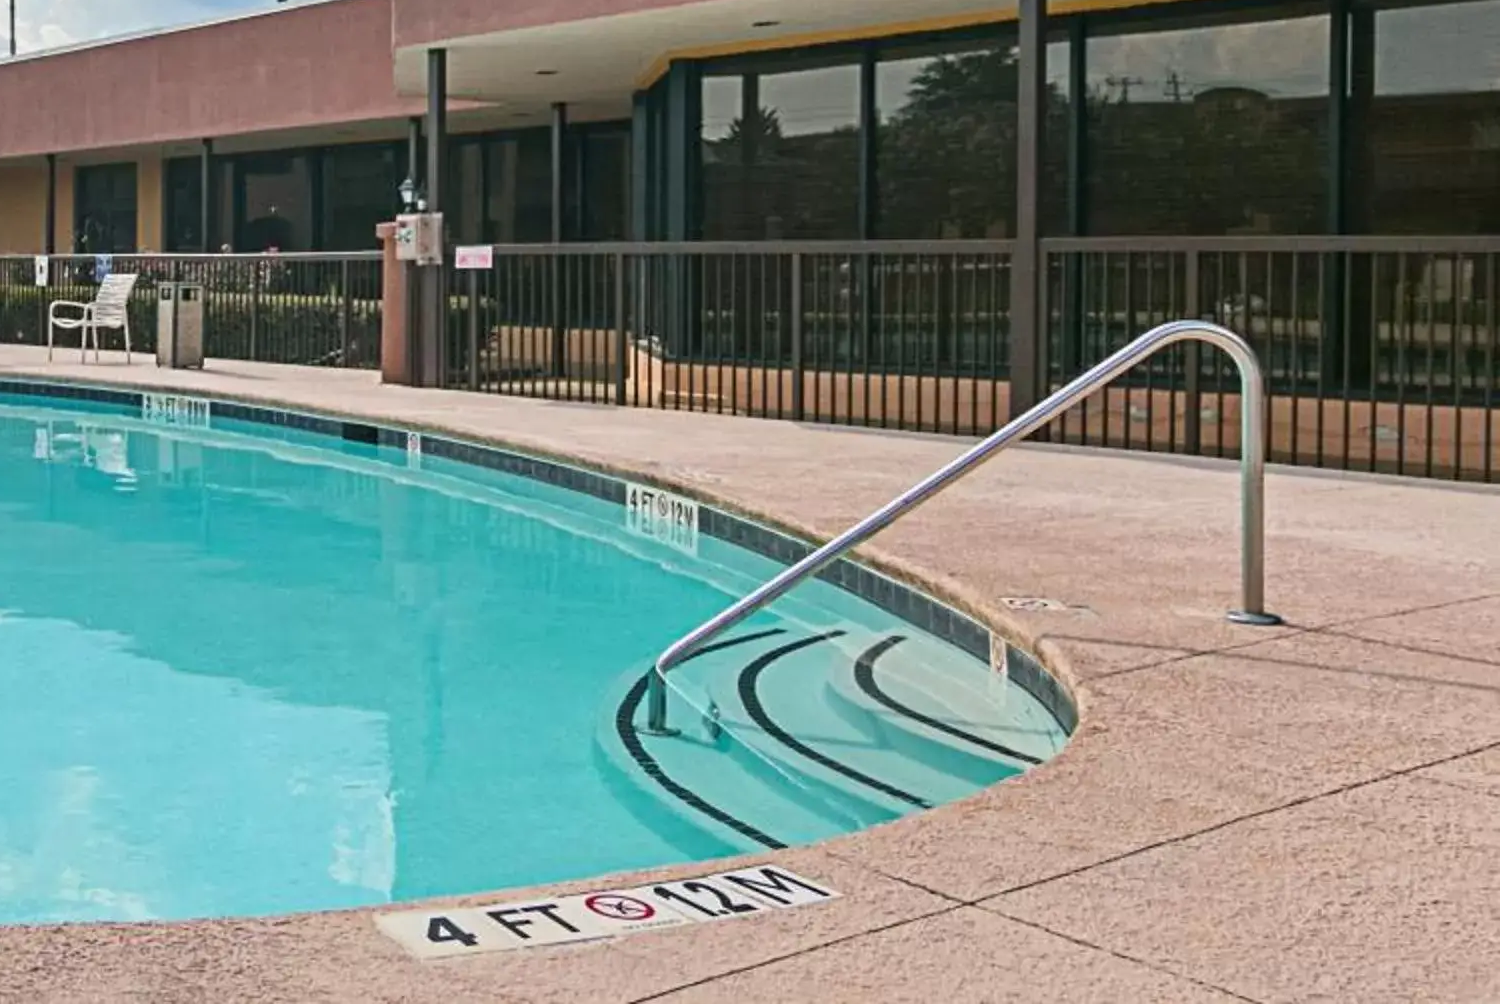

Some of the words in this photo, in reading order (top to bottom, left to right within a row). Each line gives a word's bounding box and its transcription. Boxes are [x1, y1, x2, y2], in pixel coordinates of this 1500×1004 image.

[629, 488, 637, 512] 4
[641, 491, 655, 514] FT
[427, 915, 480, 947] 4
[486, 903, 580, 939] FT
